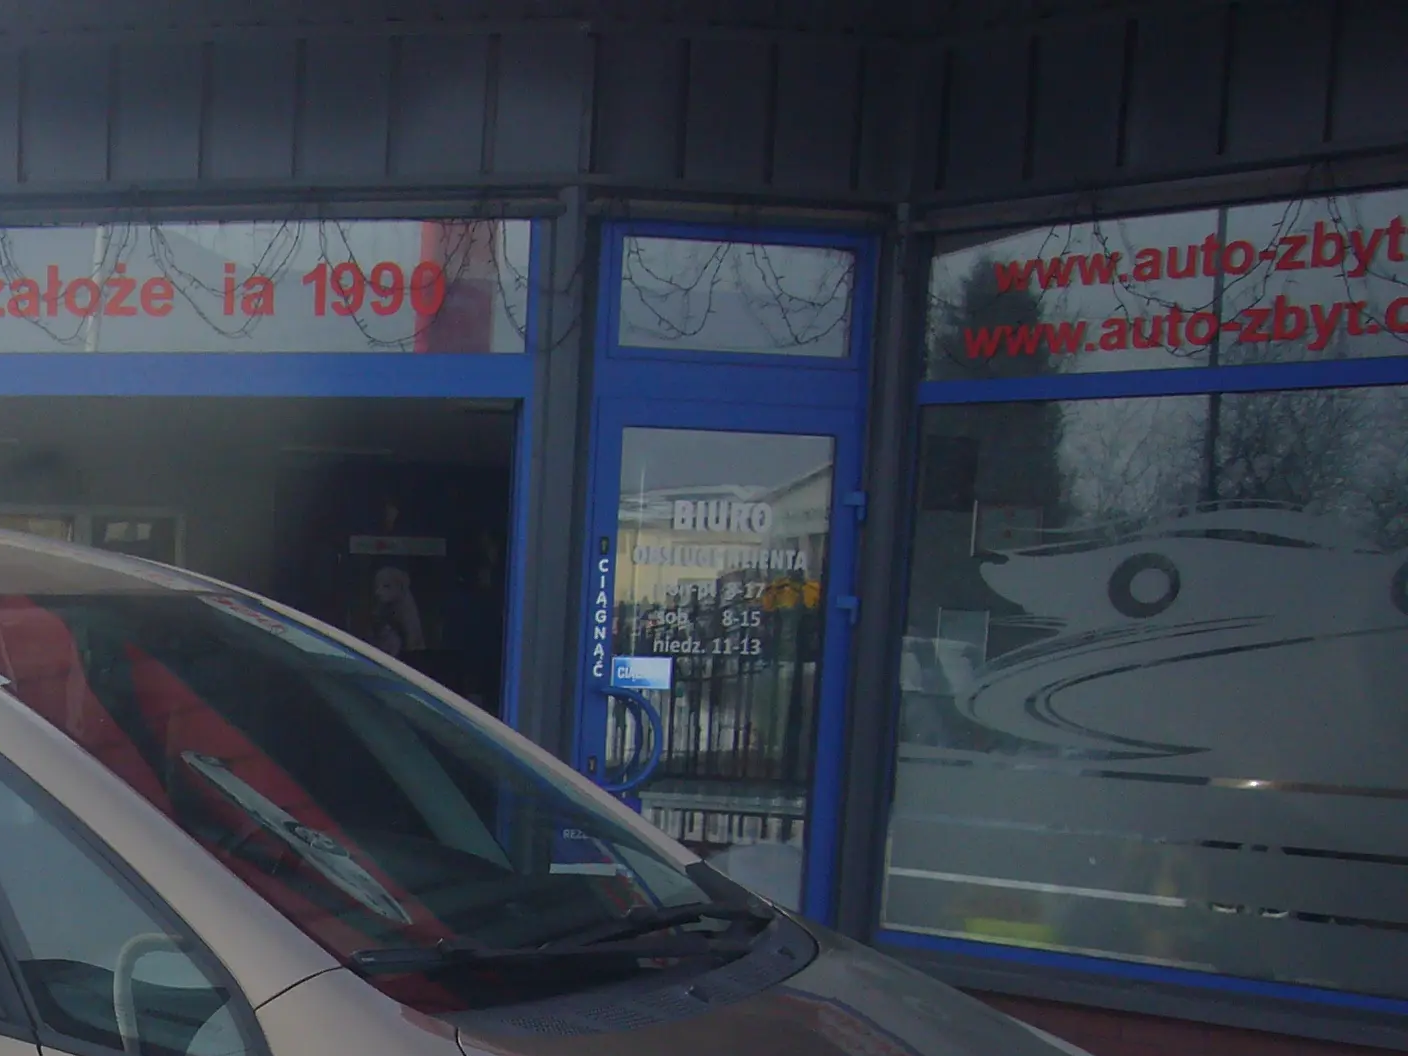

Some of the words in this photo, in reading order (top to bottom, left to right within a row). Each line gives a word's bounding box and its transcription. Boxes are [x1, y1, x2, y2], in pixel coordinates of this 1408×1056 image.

[301, 261, 447, 316] 1990
[673, 500, 773, 533] BIURO
[722, 610, 761, 627] 8-15
[653, 635, 705, 653] niedz.
[713, 638, 761, 655] 11-13
